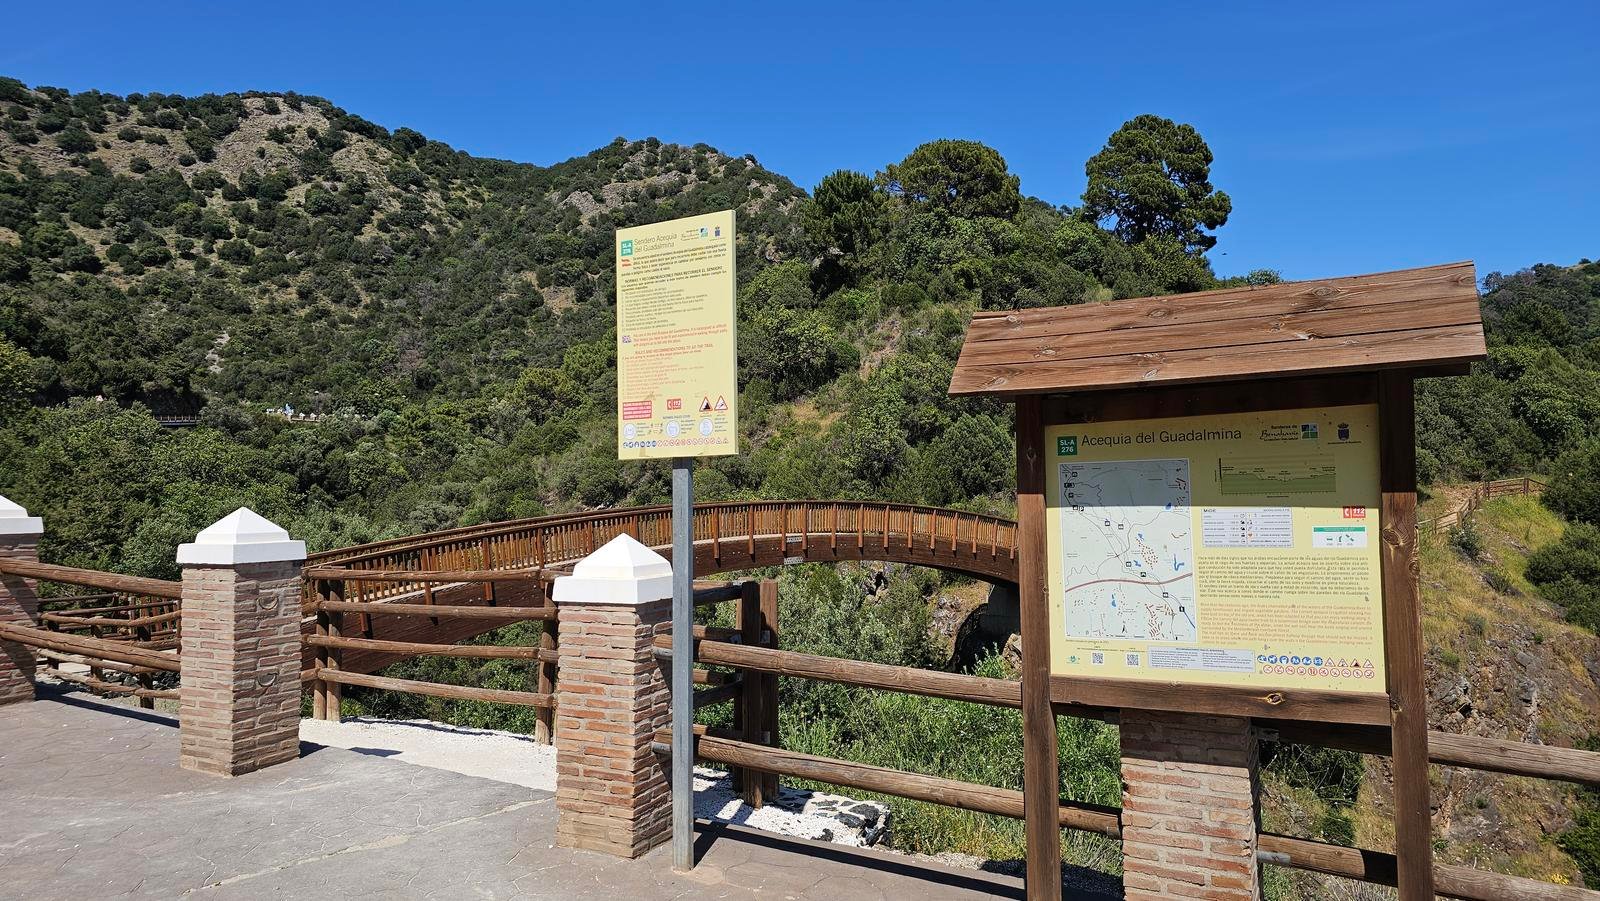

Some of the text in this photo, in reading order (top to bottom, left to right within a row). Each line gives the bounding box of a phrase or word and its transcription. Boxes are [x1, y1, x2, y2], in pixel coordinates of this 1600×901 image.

[1082, 428, 1242, 447] Acequia del Guadalmina
